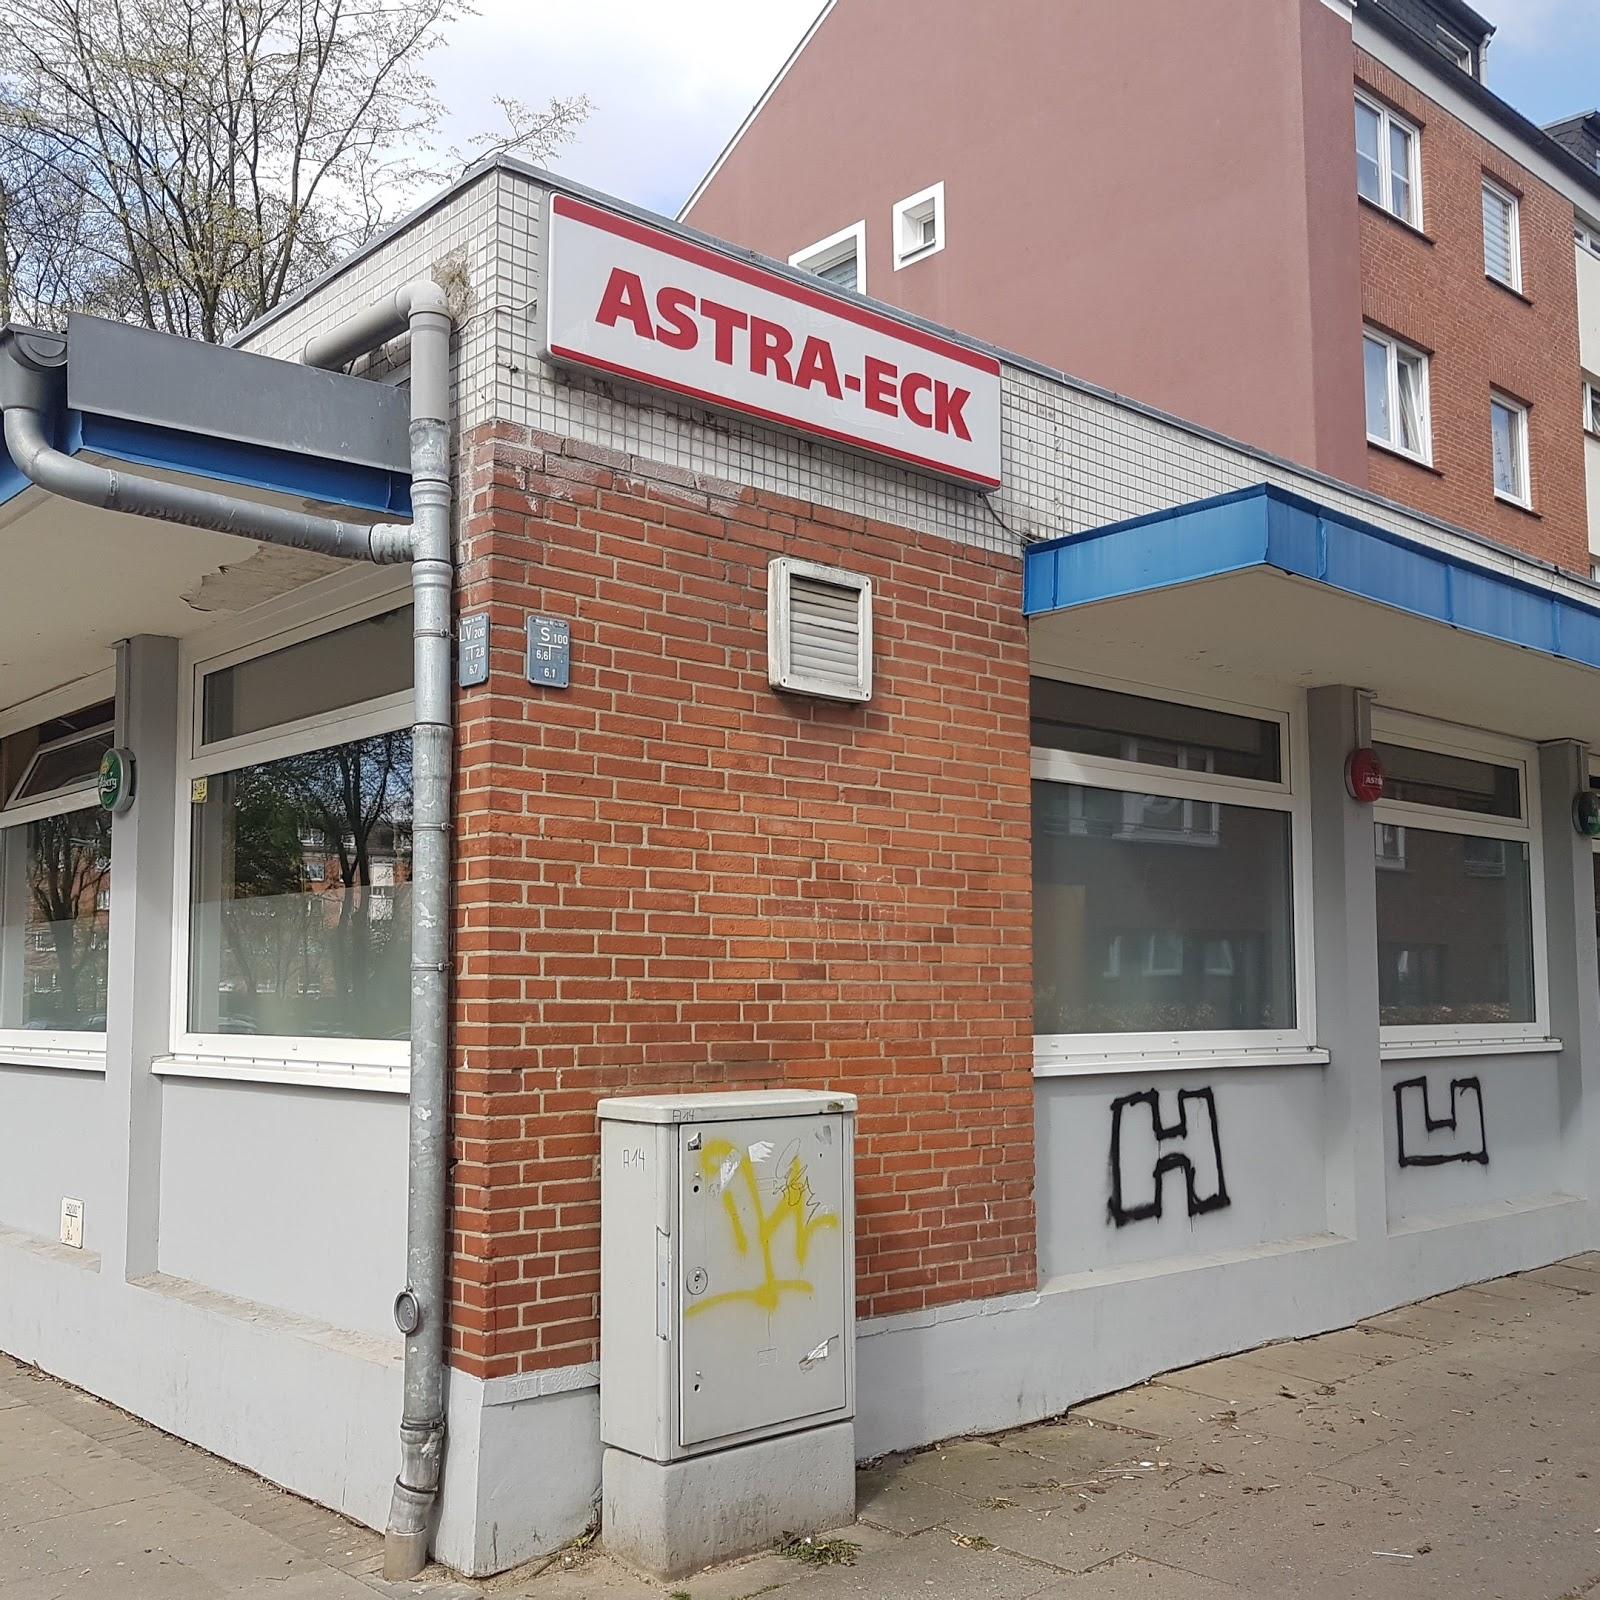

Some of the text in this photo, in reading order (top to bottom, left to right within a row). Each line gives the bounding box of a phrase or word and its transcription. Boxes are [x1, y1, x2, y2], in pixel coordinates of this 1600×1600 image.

[595, 266, 973, 442] ASTRA-ECK
[459, 625, 486, 642] LV 200
[540, 626, 568, 645] S 100
[673, 1109, 695, 1122] A14
[623, 1147, 646, 1172] A14
[1108, 1086, 1231, 1228] H
